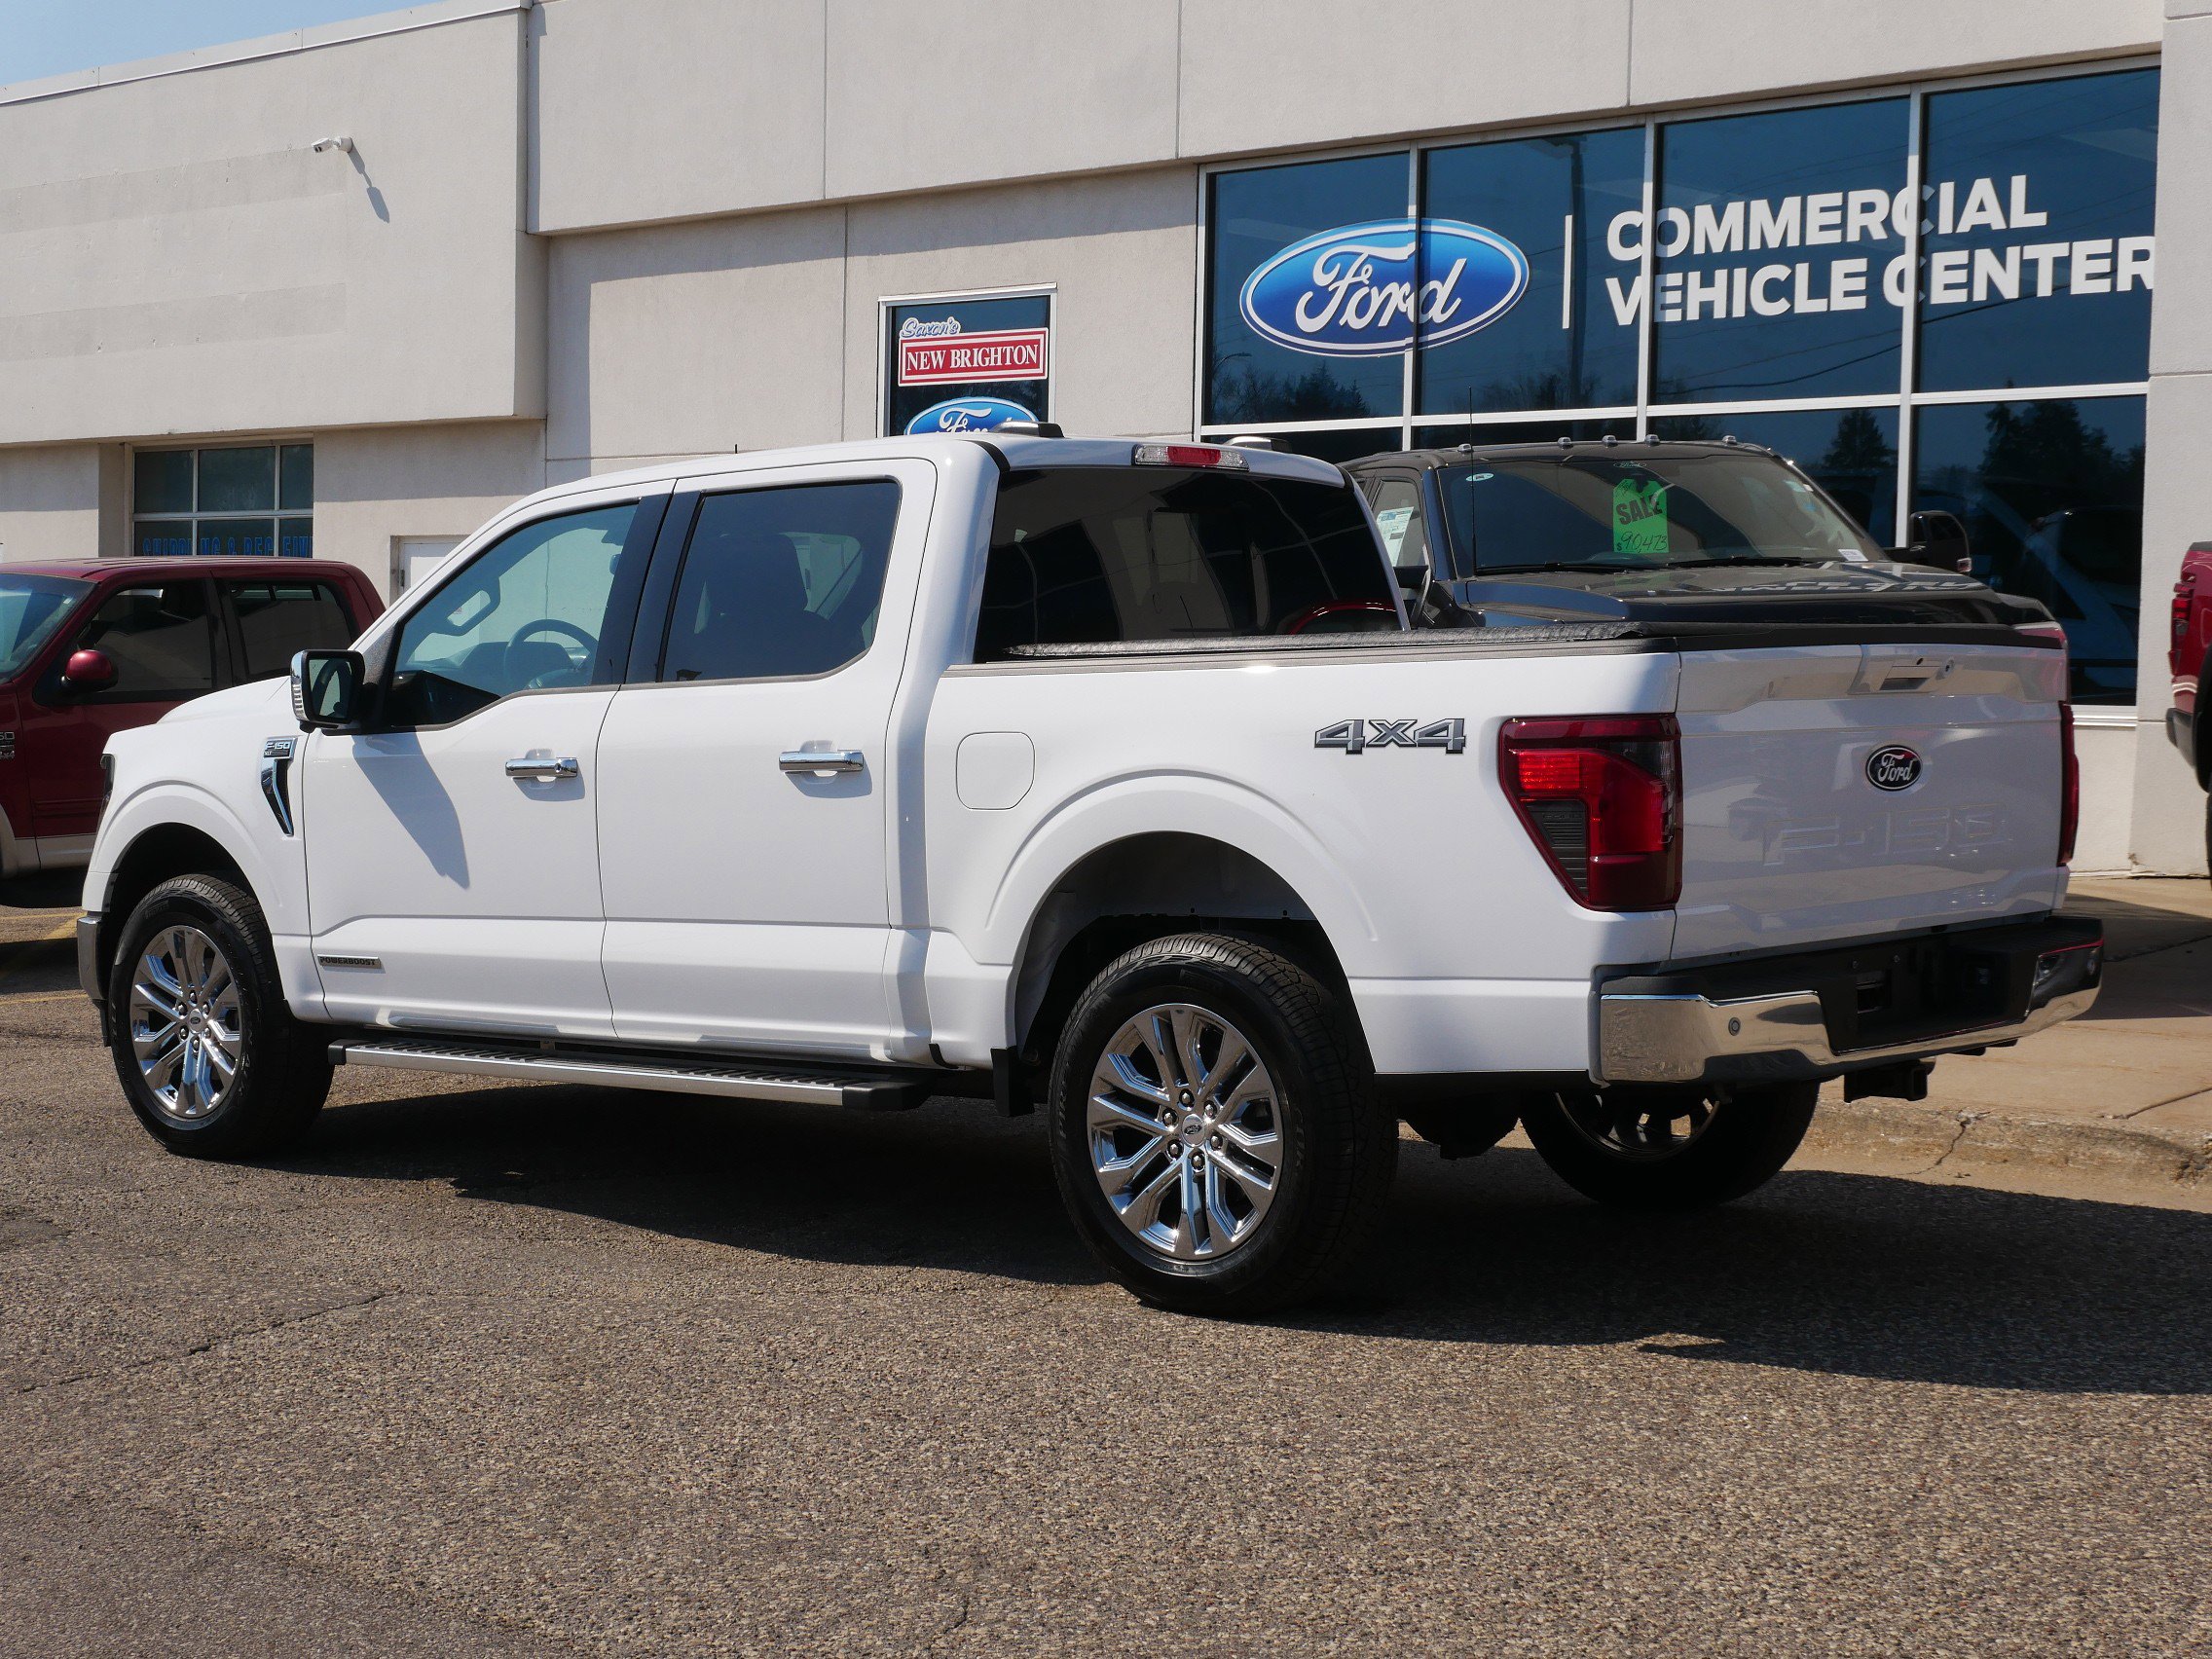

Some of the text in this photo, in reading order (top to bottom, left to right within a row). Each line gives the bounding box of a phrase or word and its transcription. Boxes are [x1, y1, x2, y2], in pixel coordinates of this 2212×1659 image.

[1606, 174, 2047, 261] COMMERCIAL
[1295, 240, 1467, 333] Ford
[1604, 236, 2156, 326] VEHICLE CENTER
[901, 317, 960, 338] Saxon's
[906, 344, 1039, 371] NEW BRIGHTON
[1616, 495, 1663, 526] SALE
[264, 741, 291, 751] F-150
[1877, 753, 1914, 782] Ford
[320, 956, 376, 965] POWERBOOST
